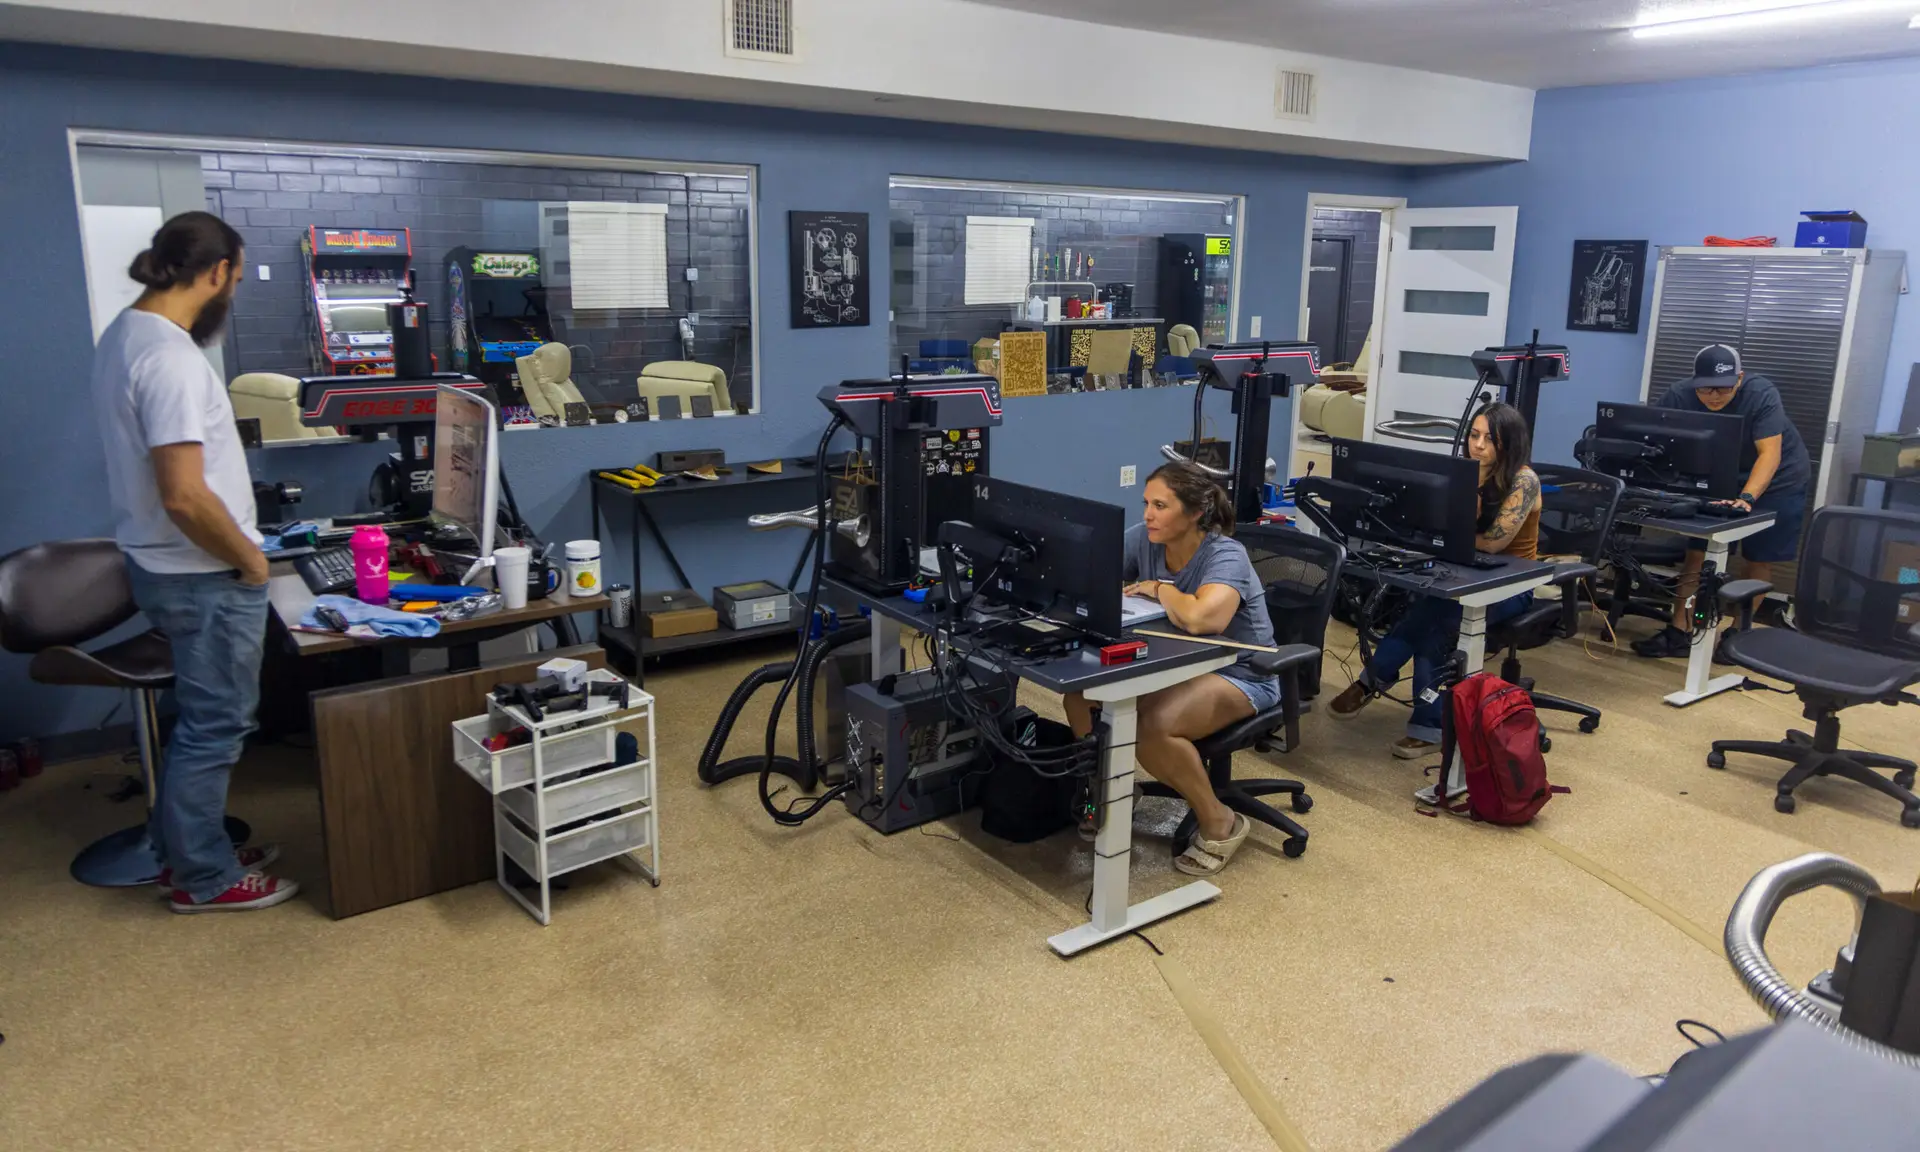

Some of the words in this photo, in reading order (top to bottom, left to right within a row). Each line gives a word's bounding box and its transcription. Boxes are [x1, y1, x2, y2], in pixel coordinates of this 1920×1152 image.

[342, 399, 408, 417] EDGE
[1599, 407, 1615, 418] 16
[1334, 444, 1349, 458] 15
[836, 485, 858, 513] SA
[974, 484, 989, 500] 14
